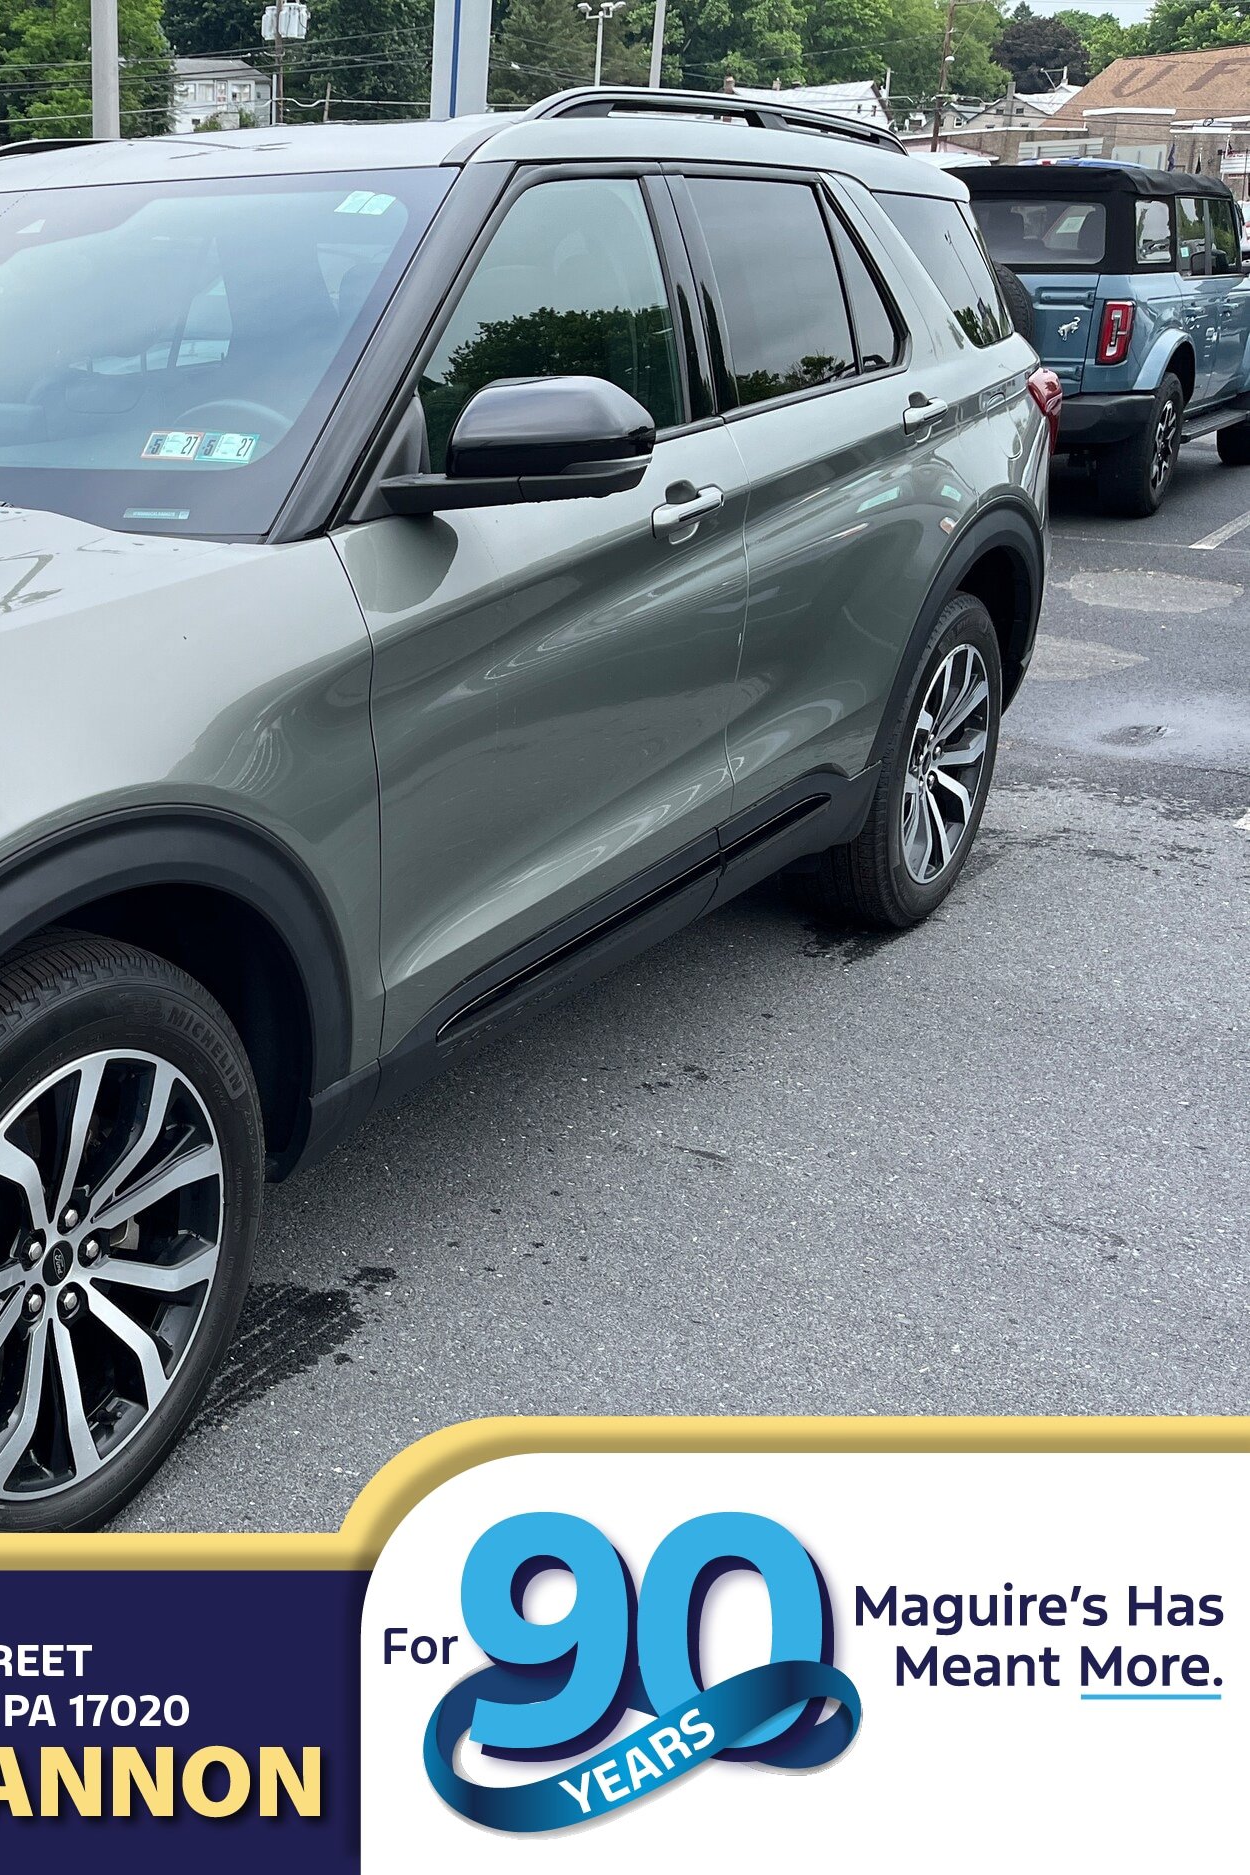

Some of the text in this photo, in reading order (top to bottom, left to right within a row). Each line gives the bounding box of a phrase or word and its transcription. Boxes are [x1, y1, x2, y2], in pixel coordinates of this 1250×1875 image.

[150, 437, 199, 455] 5 27
[203, 438, 254, 457] 5 27
[167, 1006, 243, 1092] MICHELIN
